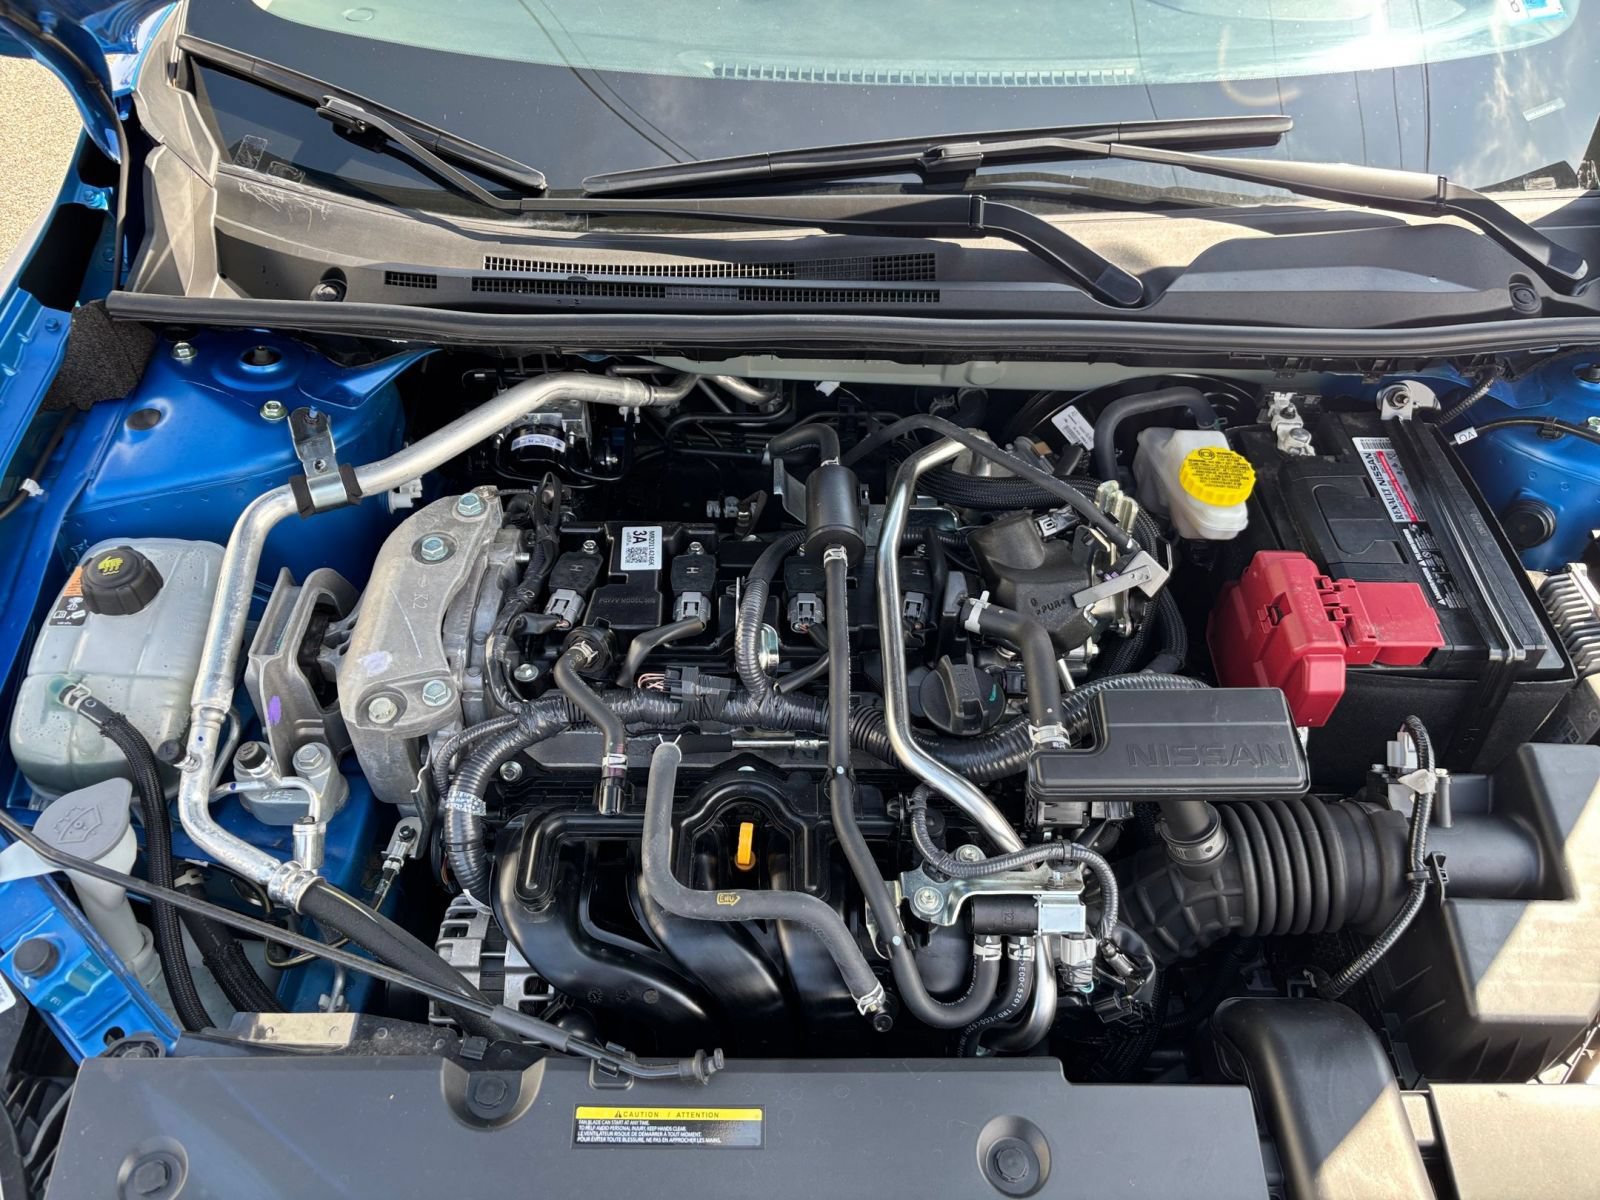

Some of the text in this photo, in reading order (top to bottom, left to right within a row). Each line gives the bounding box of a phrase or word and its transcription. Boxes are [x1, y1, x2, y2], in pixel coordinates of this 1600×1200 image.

[1364, 452, 1387, 486] NISSAN
[1383, 487, 1404, 520] RENAULT
[632, 530, 647, 544] 3A
[1126, 743, 1292, 768] NISSAN
